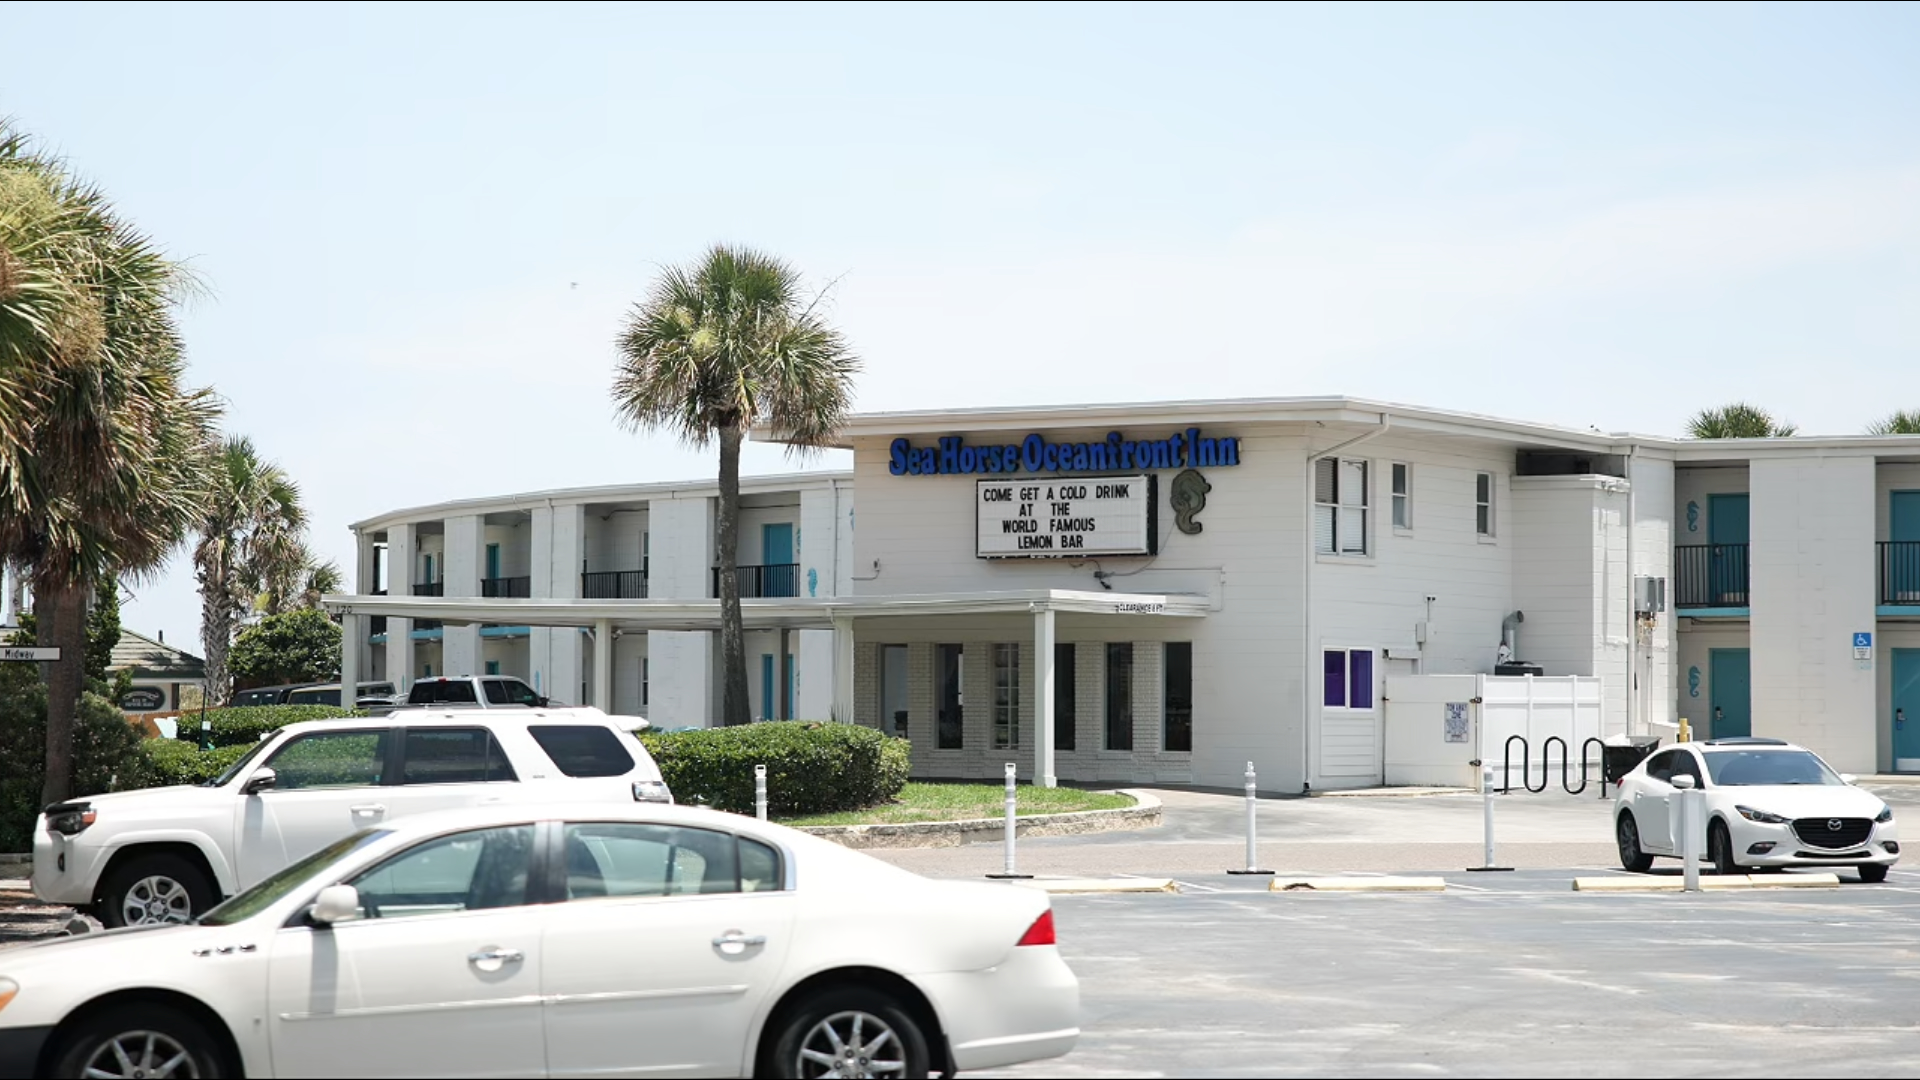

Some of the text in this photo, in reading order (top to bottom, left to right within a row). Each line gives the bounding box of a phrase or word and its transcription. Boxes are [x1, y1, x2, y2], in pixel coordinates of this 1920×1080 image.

[1022, 431, 1184, 472] Oceanfront
[1185, 428, 1240, 467] Inn
[983, 484, 1129, 501] COME GET A COLD DRINK
[1019, 502, 1070, 517] AT THE
[1002, 518, 1096, 533] WORLD FAMOUS
[1018, 534, 1083, 549] LEMON BAR
[336, 605, 353, 614] 120
[1119, 603, 1151, 613] CLEARANCE
[5, 649, 35, 659] Midway
